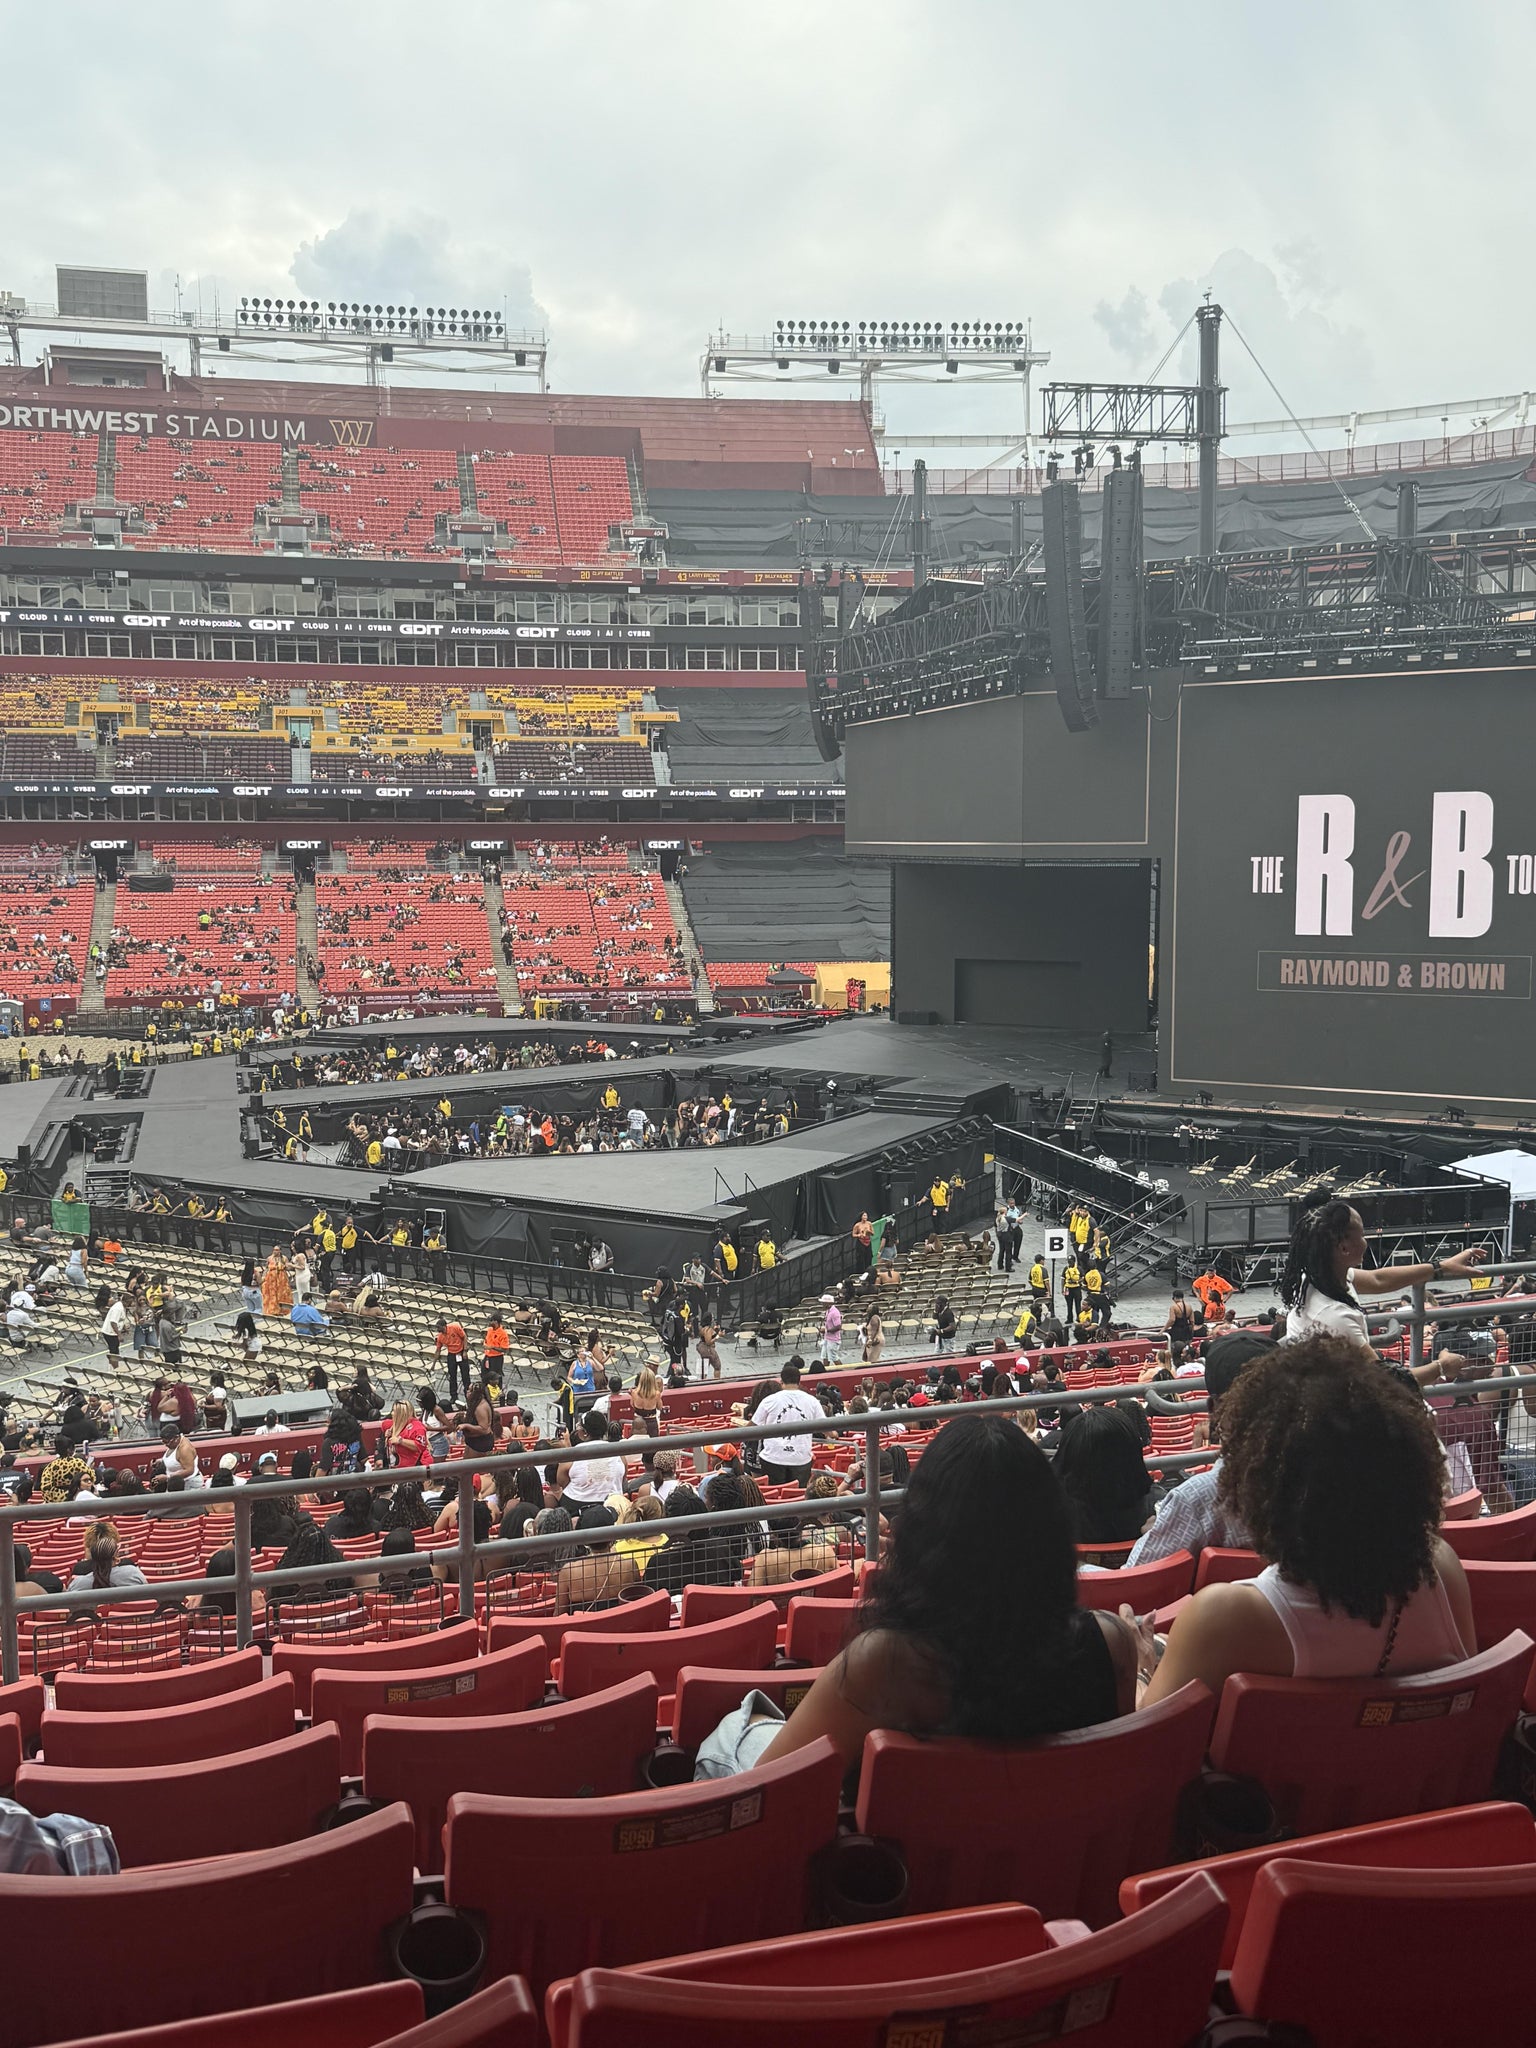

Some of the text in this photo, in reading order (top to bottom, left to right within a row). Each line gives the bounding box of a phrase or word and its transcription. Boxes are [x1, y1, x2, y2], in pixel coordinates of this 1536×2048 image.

[165, 414, 306, 441] STADIUM
[580, 570, 591, 580] 20
[677, 572, 688, 582] 43
[754, 574, 763, 583] 17
[18, 613, 116, 623] CLOUD AI CYBER
[122, 614, 171, 627] GDIT
[178, 617, 191, 626] Art
[199, 618, 211, 627] the
[248, 619, 295, 631] GDIT
[302, 622, 393, 632] CLOUD AI CYBER
[399, 624, 444, 635] GDIT
[450, 626, 462, 634] Art
[470, 627, 481, 635] the
[516, 626, 559, 638] GDIT
[566, 629, 651, 638] CLOUD AI CYBER
[13, 785, 39, 793] CLOUD
[73, 785, 96, 793] CYBER
[110, 785, 151, 795] GDIT
[165, 786, 176, 794] Art
[232, 786, 272, 796] GDIT
[286, 787, 309, 795] CLOUD
[375, 787, 413, 797] GDIT
[488, 788, 525, 798] GDIT
[621, 789, 657, 798] GDIT
[729, 789, 764, 798] GDIT
[90, 840, 127, 849] GDIT
[286, 840, 322, 849] GDIT
[470, 840, 504, 850] GDIT
[648, 840, 681, 849] GDIT
[1250, 791, 1536, 938] THE R & B TO
[1280, 958, 1506, 990] RAYMOND & BROWN
[1049, 1236, 1064, 1252] B
[388, 1691, 409, 1701] 5050
[1362, 1708, 1392, 1721] 5050
[620, 1828, 655, 1846] 5050
